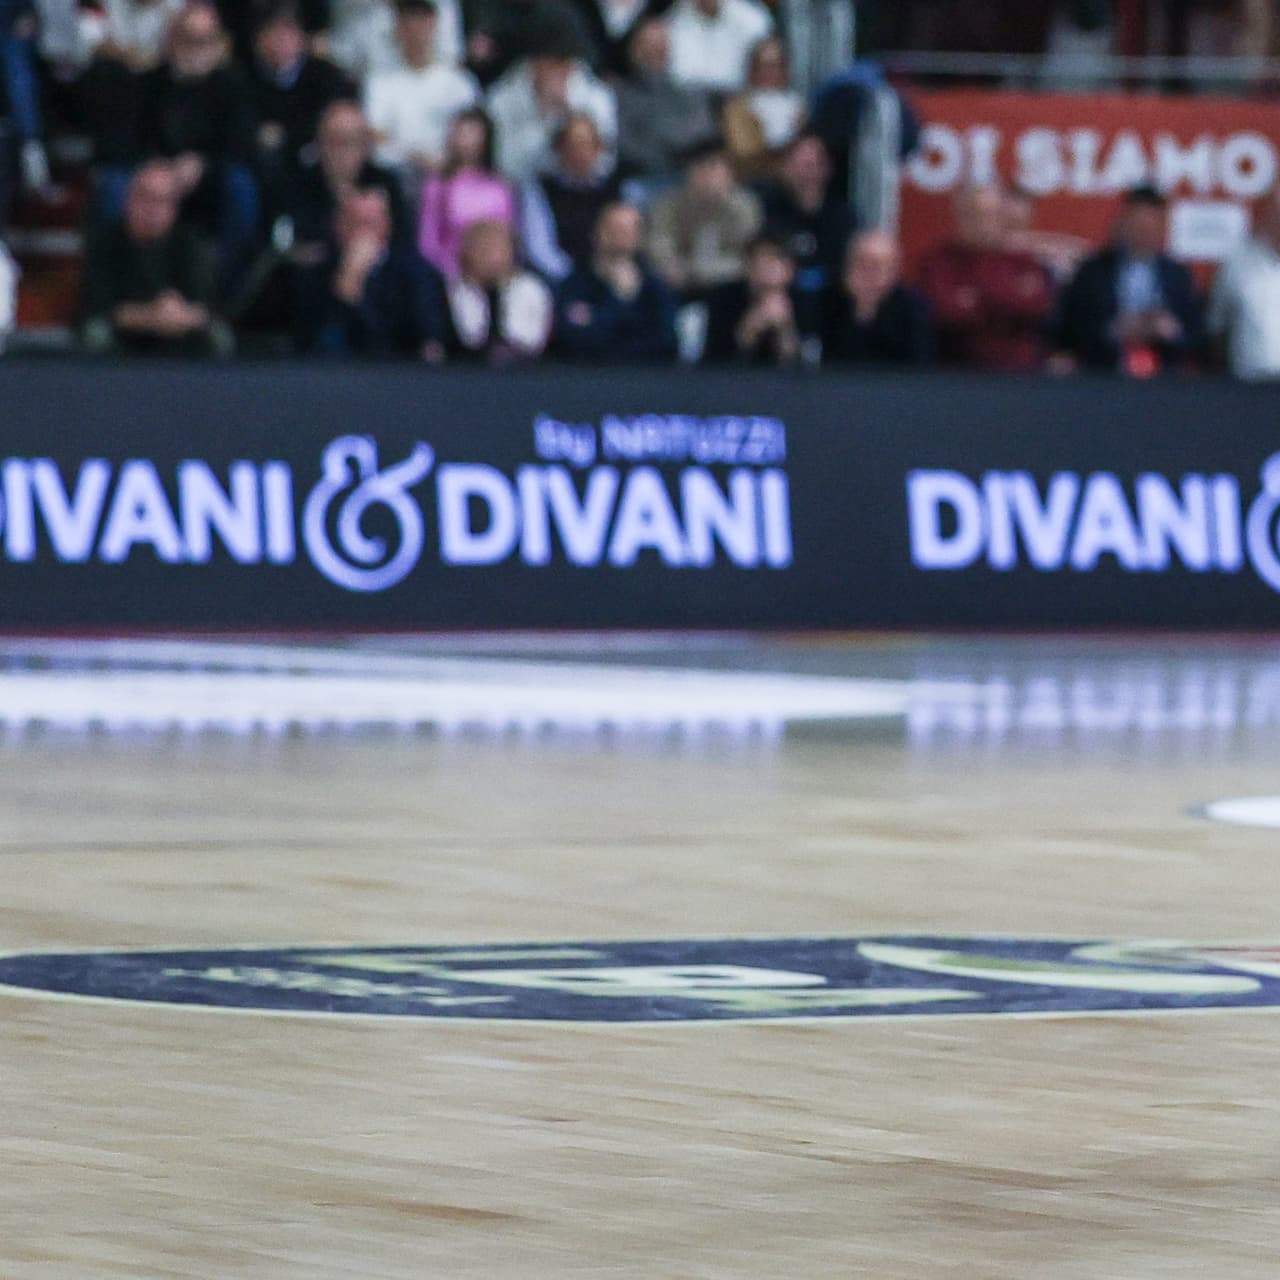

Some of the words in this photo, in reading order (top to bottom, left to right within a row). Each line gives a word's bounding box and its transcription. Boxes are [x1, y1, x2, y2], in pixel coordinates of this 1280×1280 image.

[1014, 126, 1280, 198] SIAMO
[0, 456, 294, 565] IVANI
[434, 461, 793, 569] DIVANI
[904, 466, 1244, 573] DIVANI
